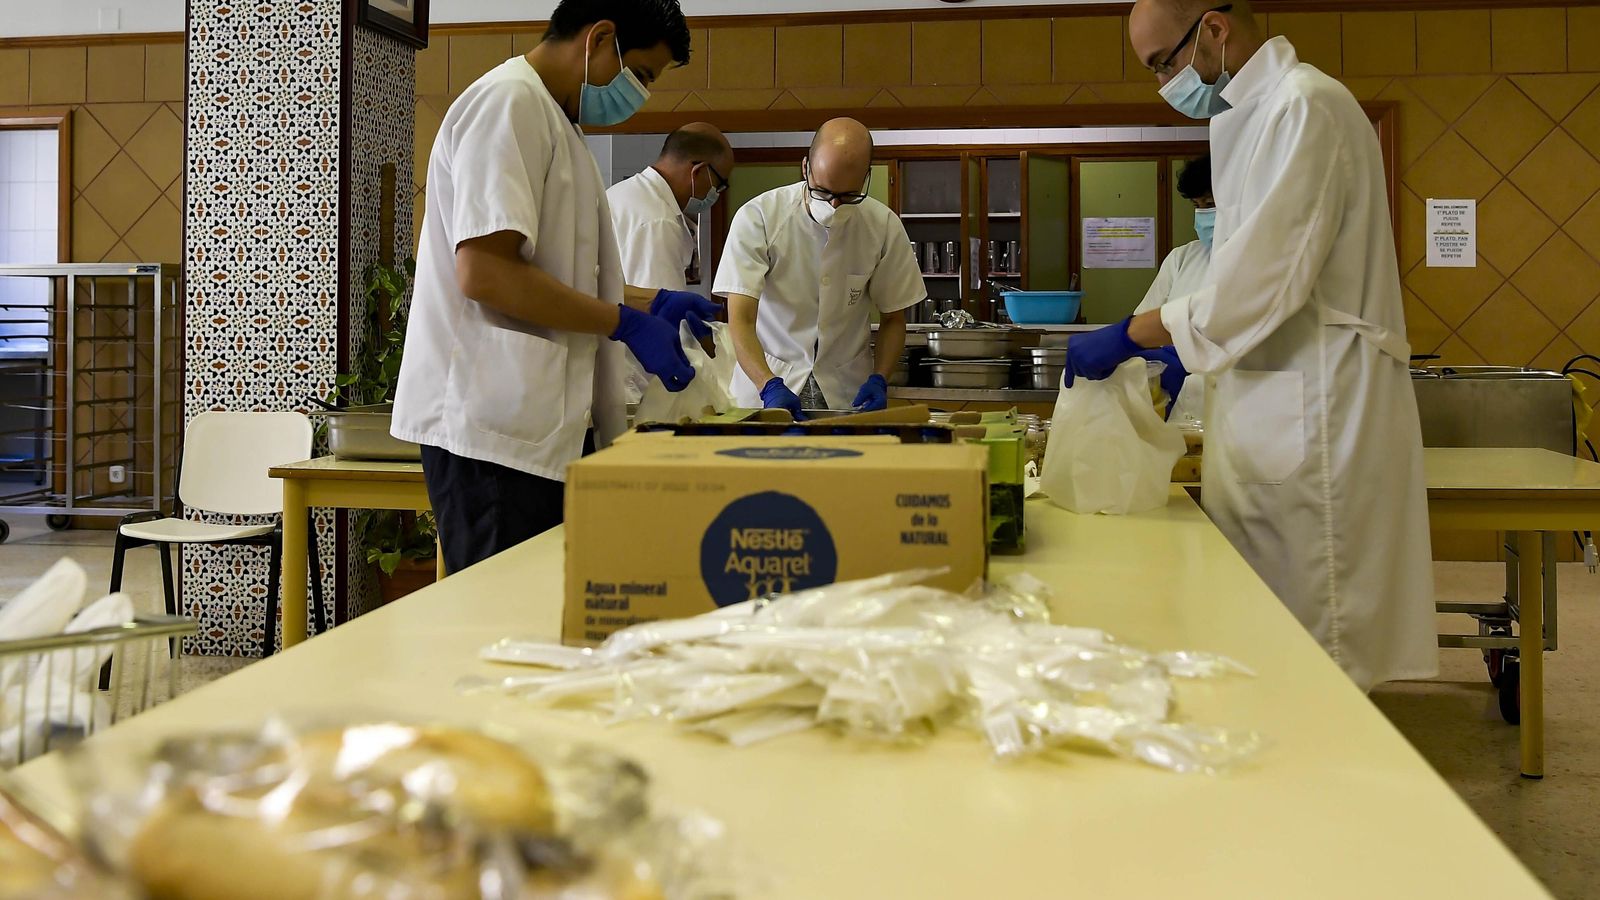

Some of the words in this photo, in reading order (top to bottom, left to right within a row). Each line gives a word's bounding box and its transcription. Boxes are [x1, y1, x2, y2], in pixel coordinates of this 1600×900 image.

[896, 493, 951, 508] CUIDAMOS
[911, 513, 924, 526] de
[900, 531, 949, 545] NATURAL
[724, 552, 811, 583] Aquarel
[585, 580, 616, 595] Agua
[619, 581, 667, 595] mineral
[585, 596, 629, 610] natural
